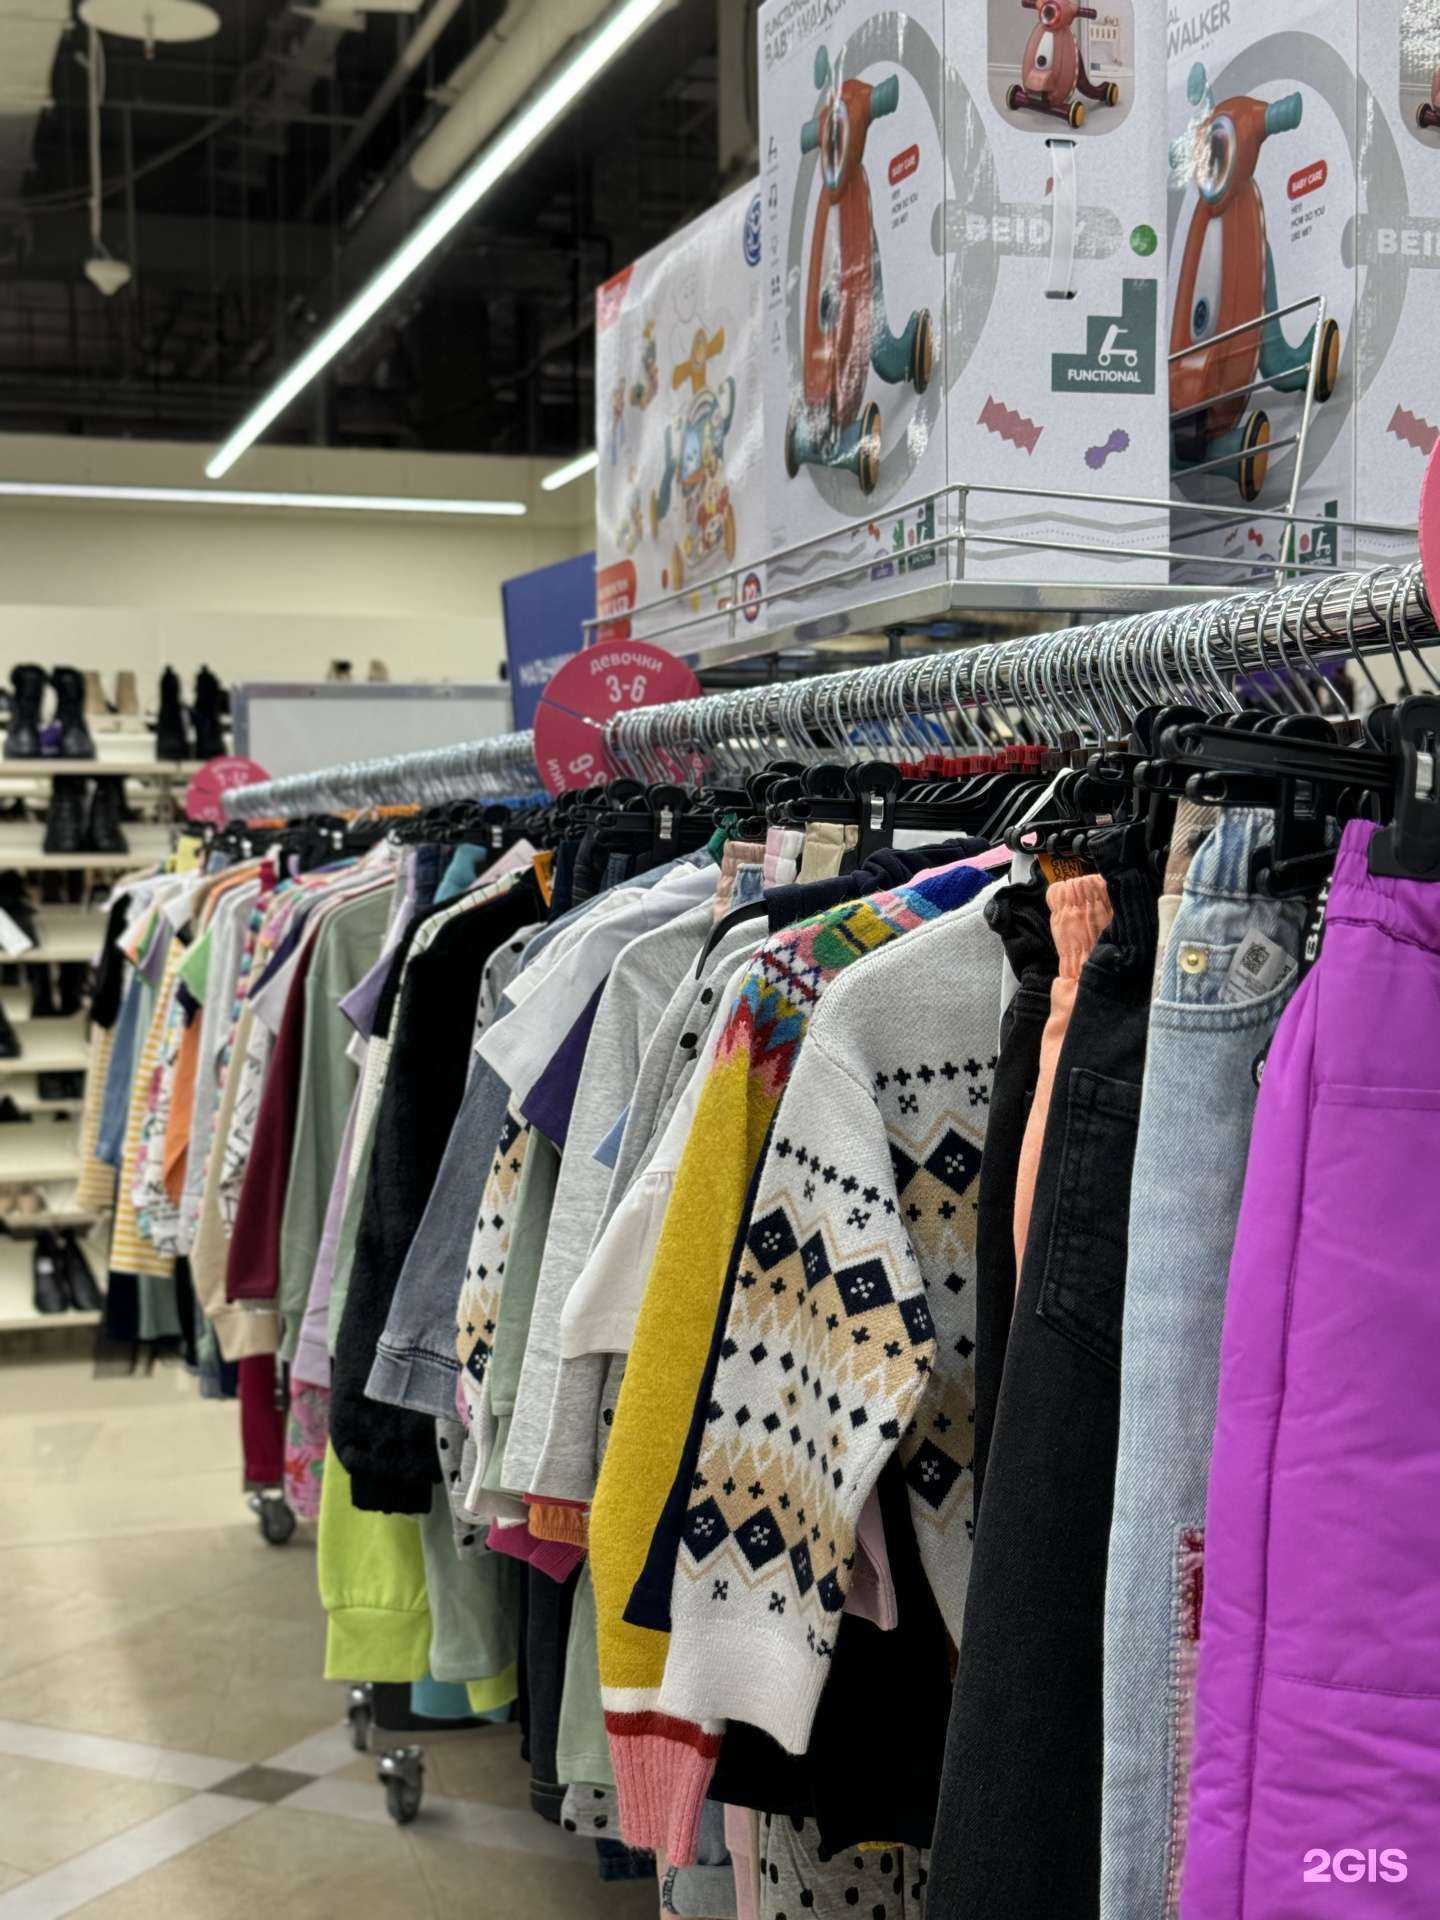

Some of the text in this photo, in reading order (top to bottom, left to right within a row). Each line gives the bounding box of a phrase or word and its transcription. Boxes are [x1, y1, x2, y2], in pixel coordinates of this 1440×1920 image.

[1377, 227, 1440, 256] BEI
[1067, 368, 1142, 383] FUNCTIONAL
[605, 674, 647, 704] 3-6
